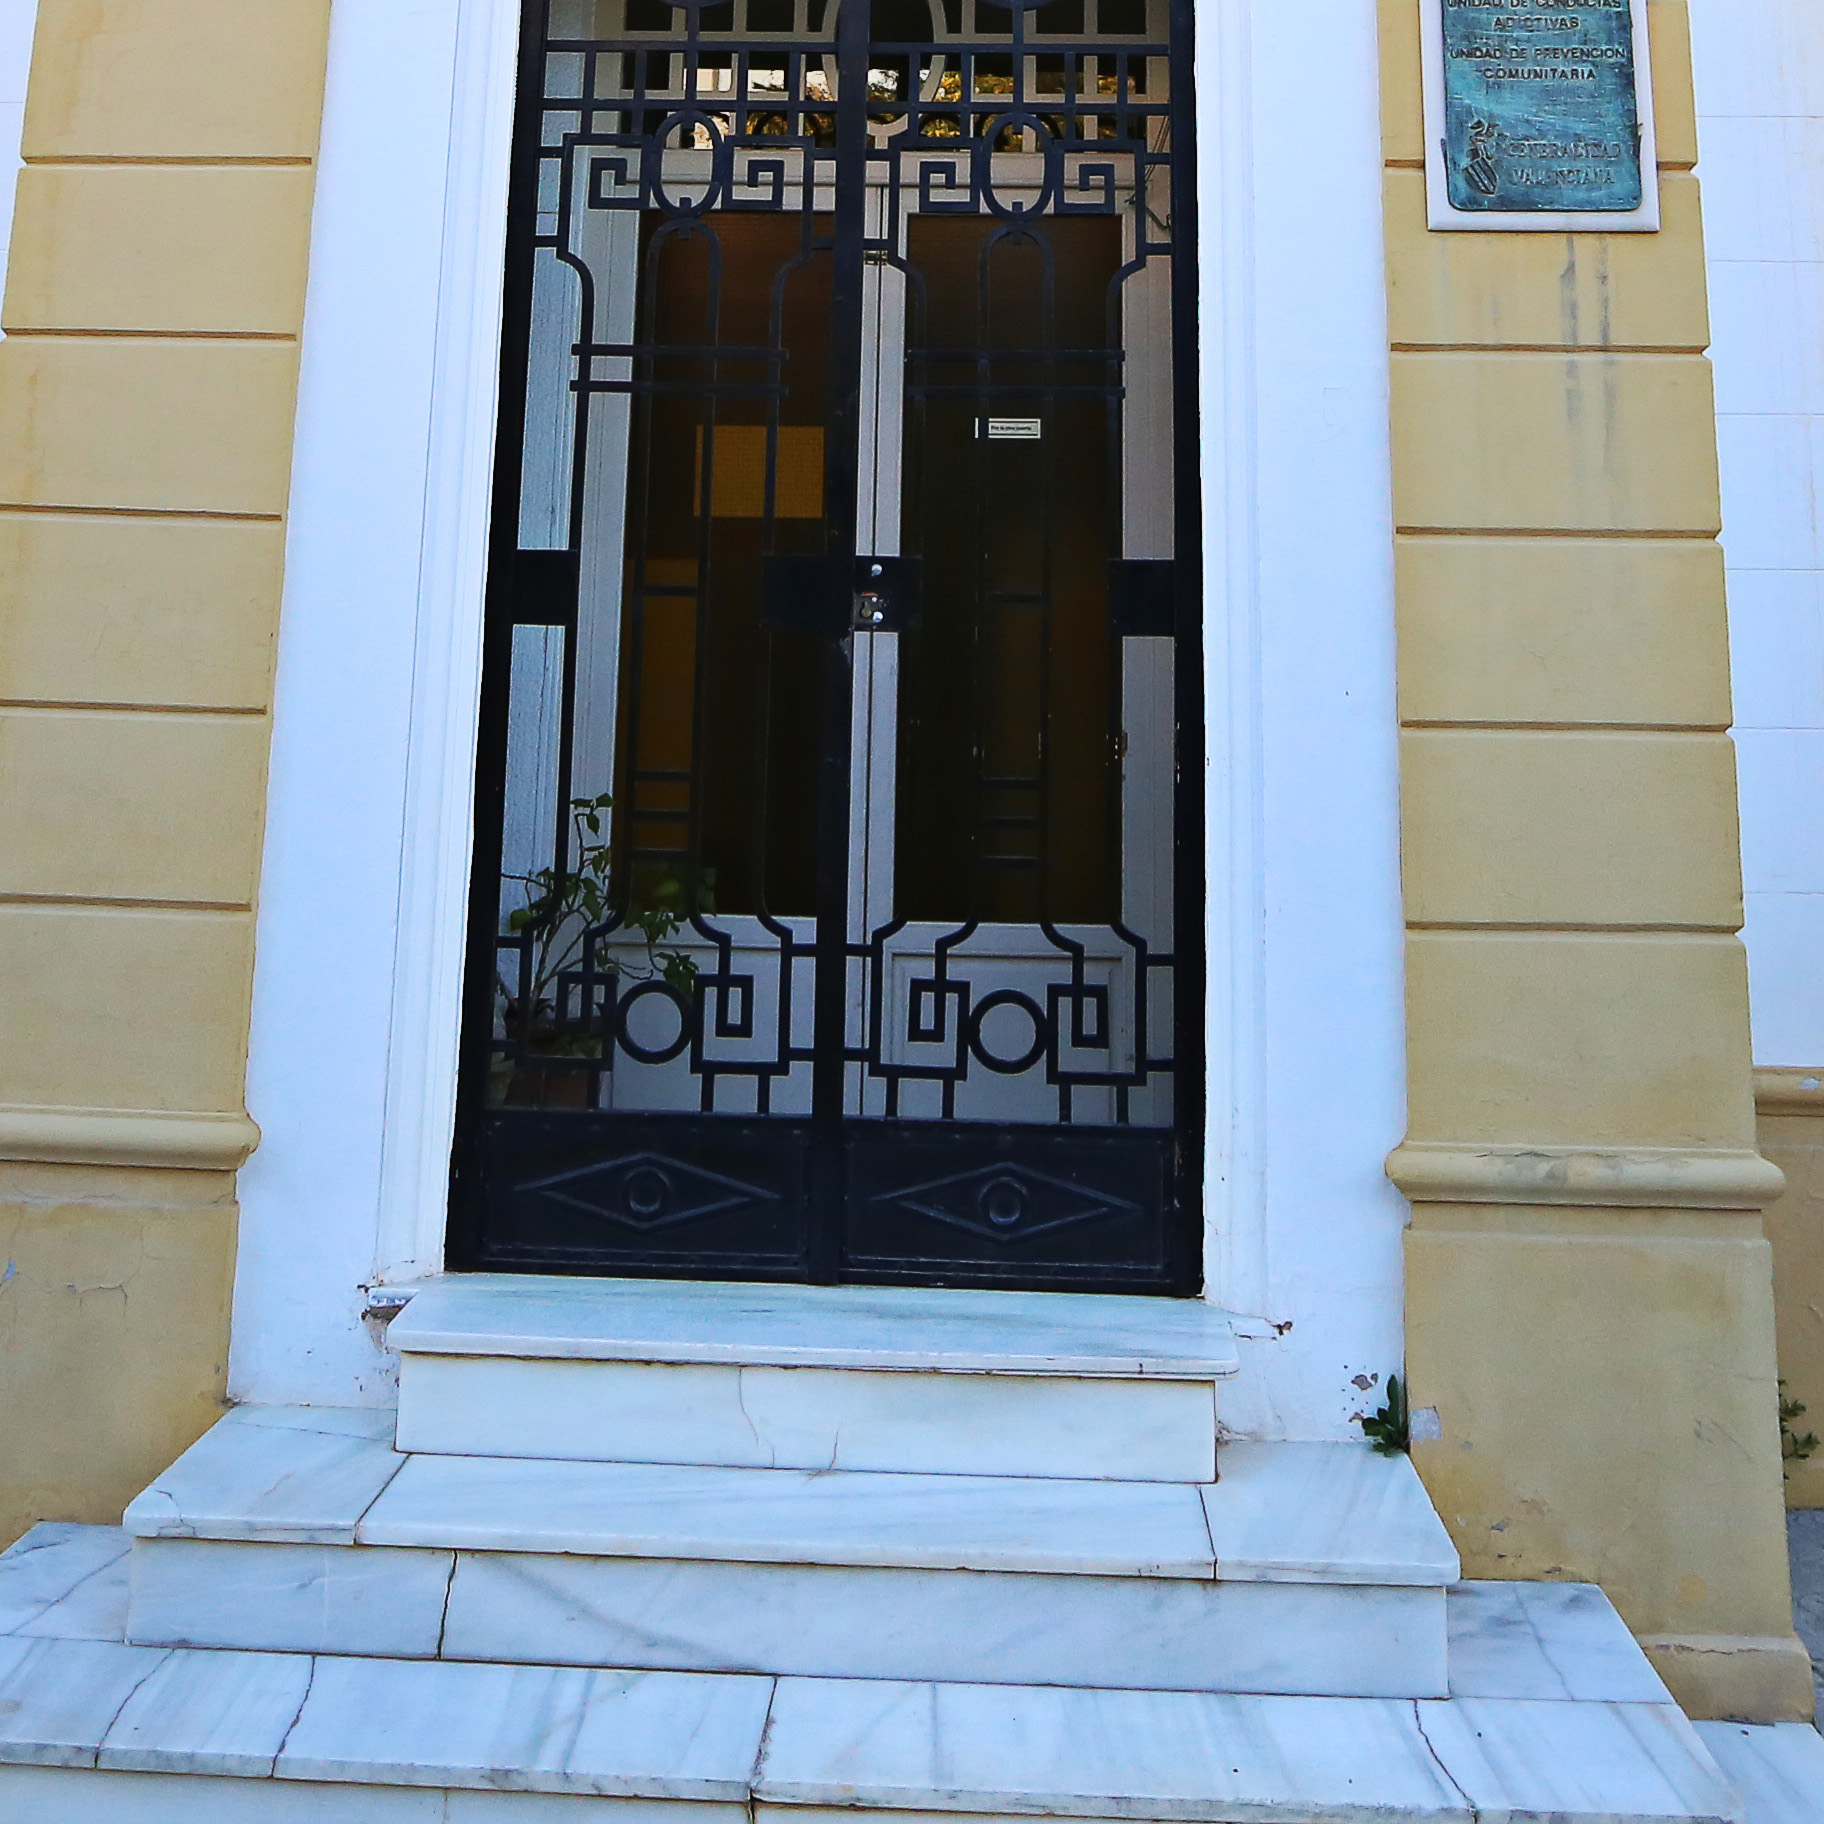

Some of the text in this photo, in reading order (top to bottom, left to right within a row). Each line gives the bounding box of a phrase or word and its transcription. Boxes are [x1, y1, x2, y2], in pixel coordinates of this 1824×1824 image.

[1449, 47, 1503, 59] UNIDAD
[1510, 47, 1528, 59] DE
[1483, 68, 1597, 80] COMUNITARIA
